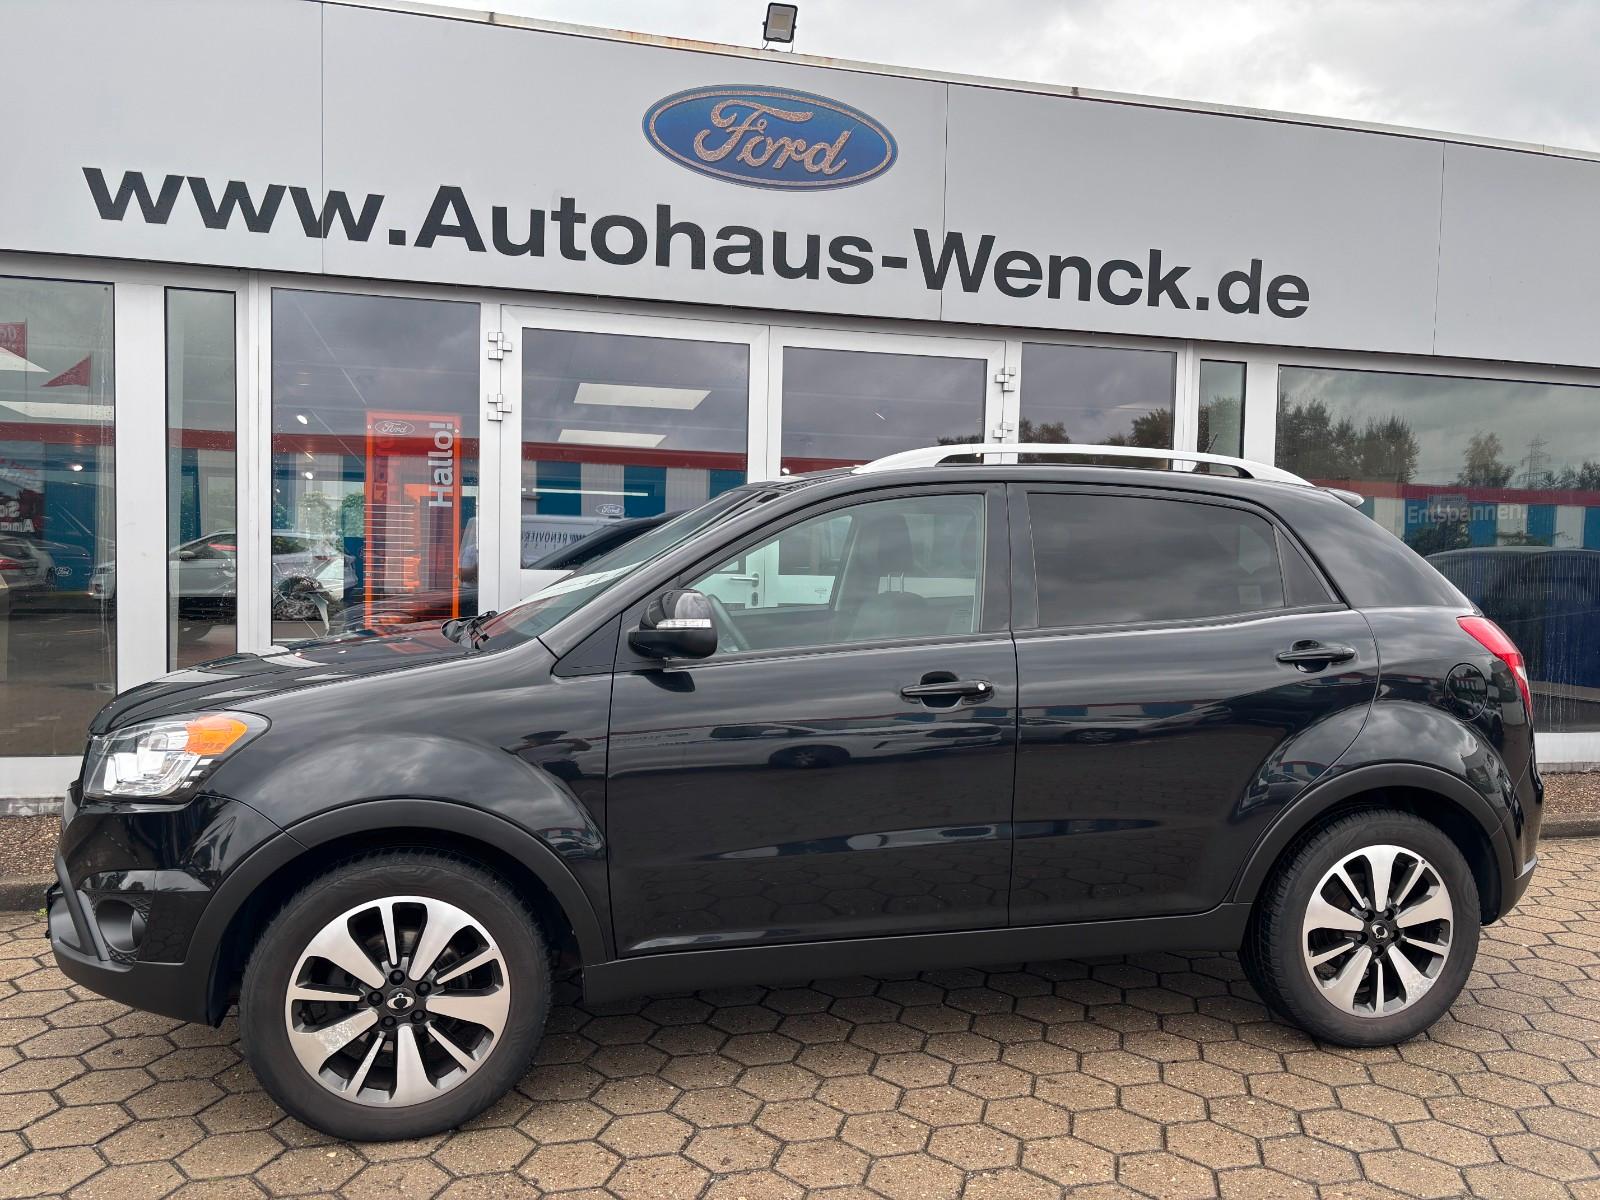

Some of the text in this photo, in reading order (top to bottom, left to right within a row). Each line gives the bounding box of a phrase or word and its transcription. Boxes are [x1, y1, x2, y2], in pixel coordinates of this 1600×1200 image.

[694, 99, 853, 175] Ford
[82, 167, 1310, 319] www.Autohaus-Wenck.de
[428, 422, 453, 507] Hallo!
